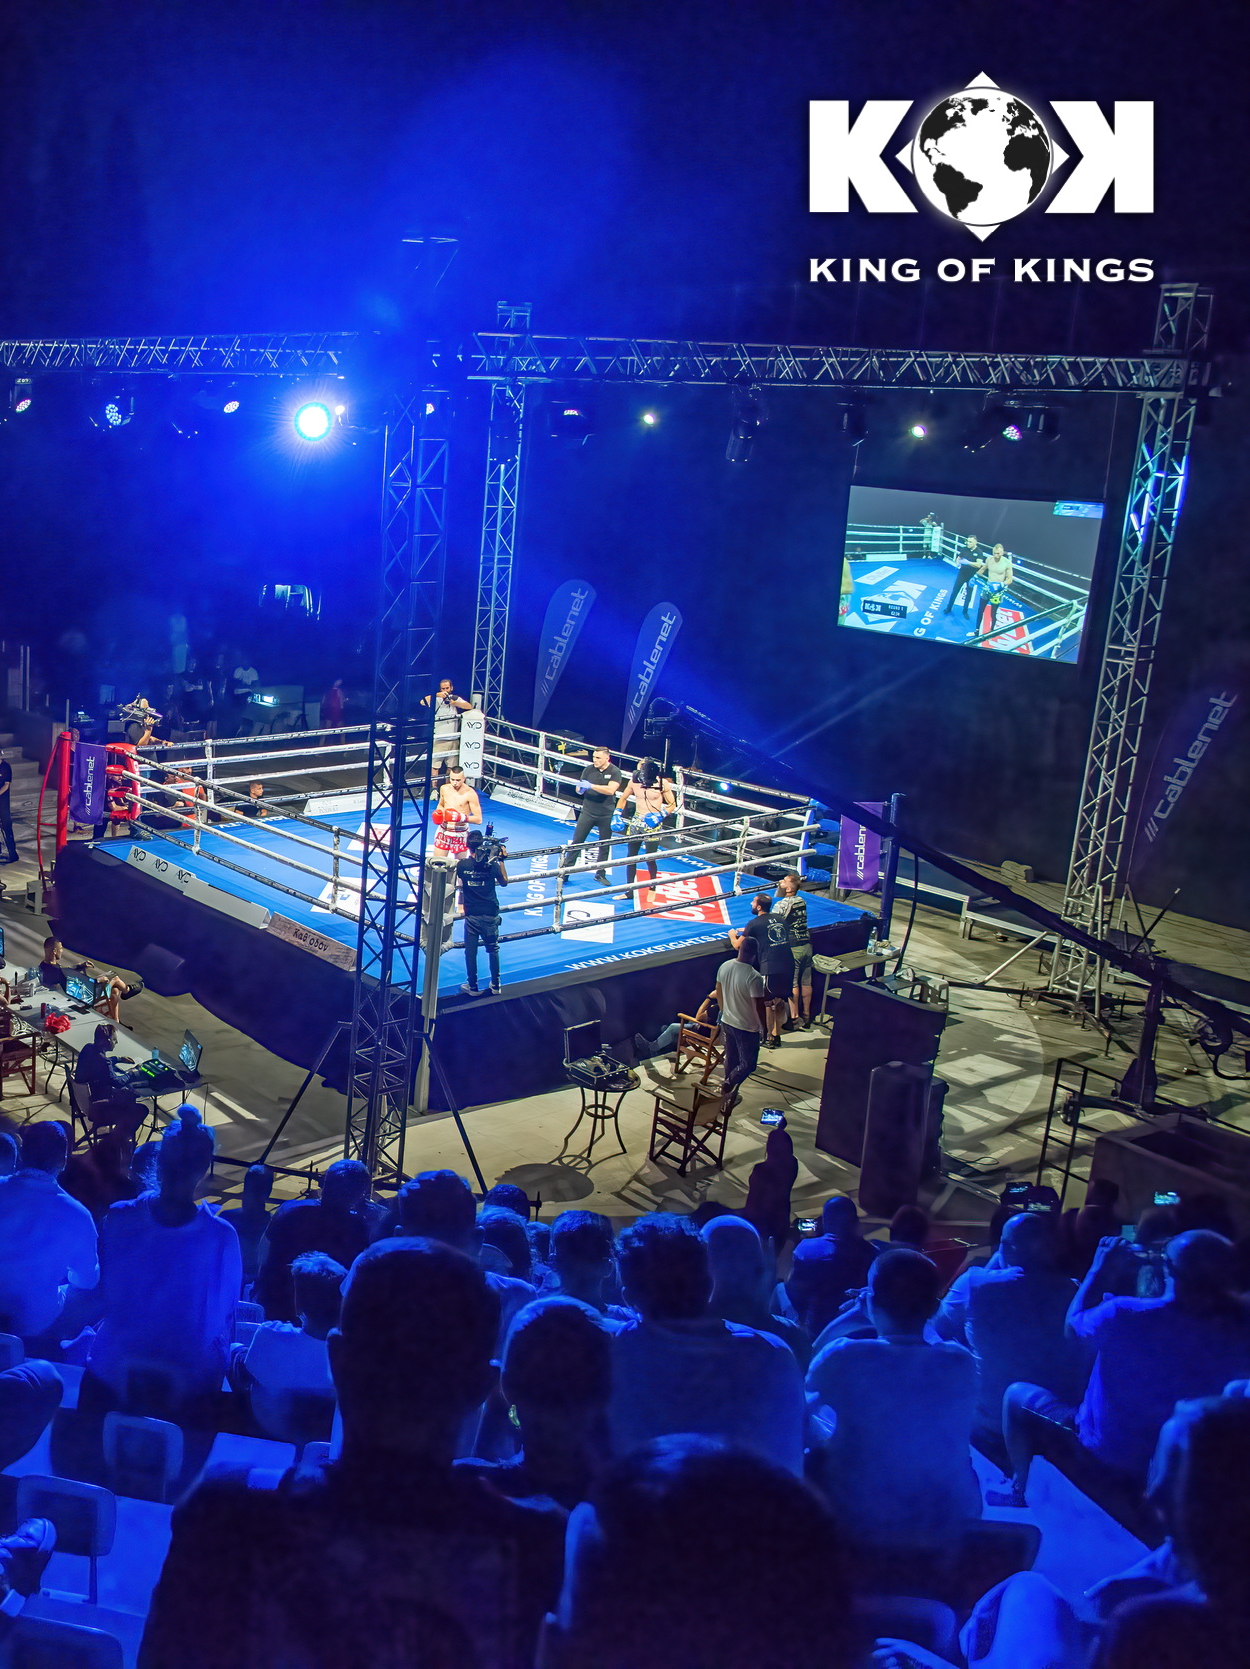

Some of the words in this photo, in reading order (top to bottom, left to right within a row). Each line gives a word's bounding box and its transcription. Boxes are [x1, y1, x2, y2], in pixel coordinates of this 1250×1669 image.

[545, 587, 589, 681] cablenet
[930, 588, 949, 611] KINGS
[632, 611, 677, 708] cablenet
[83, 755, 96, 806] cablenet
[1153, 691, 1239, 819] cablenet
[853, 824, 867, 870] cablen
